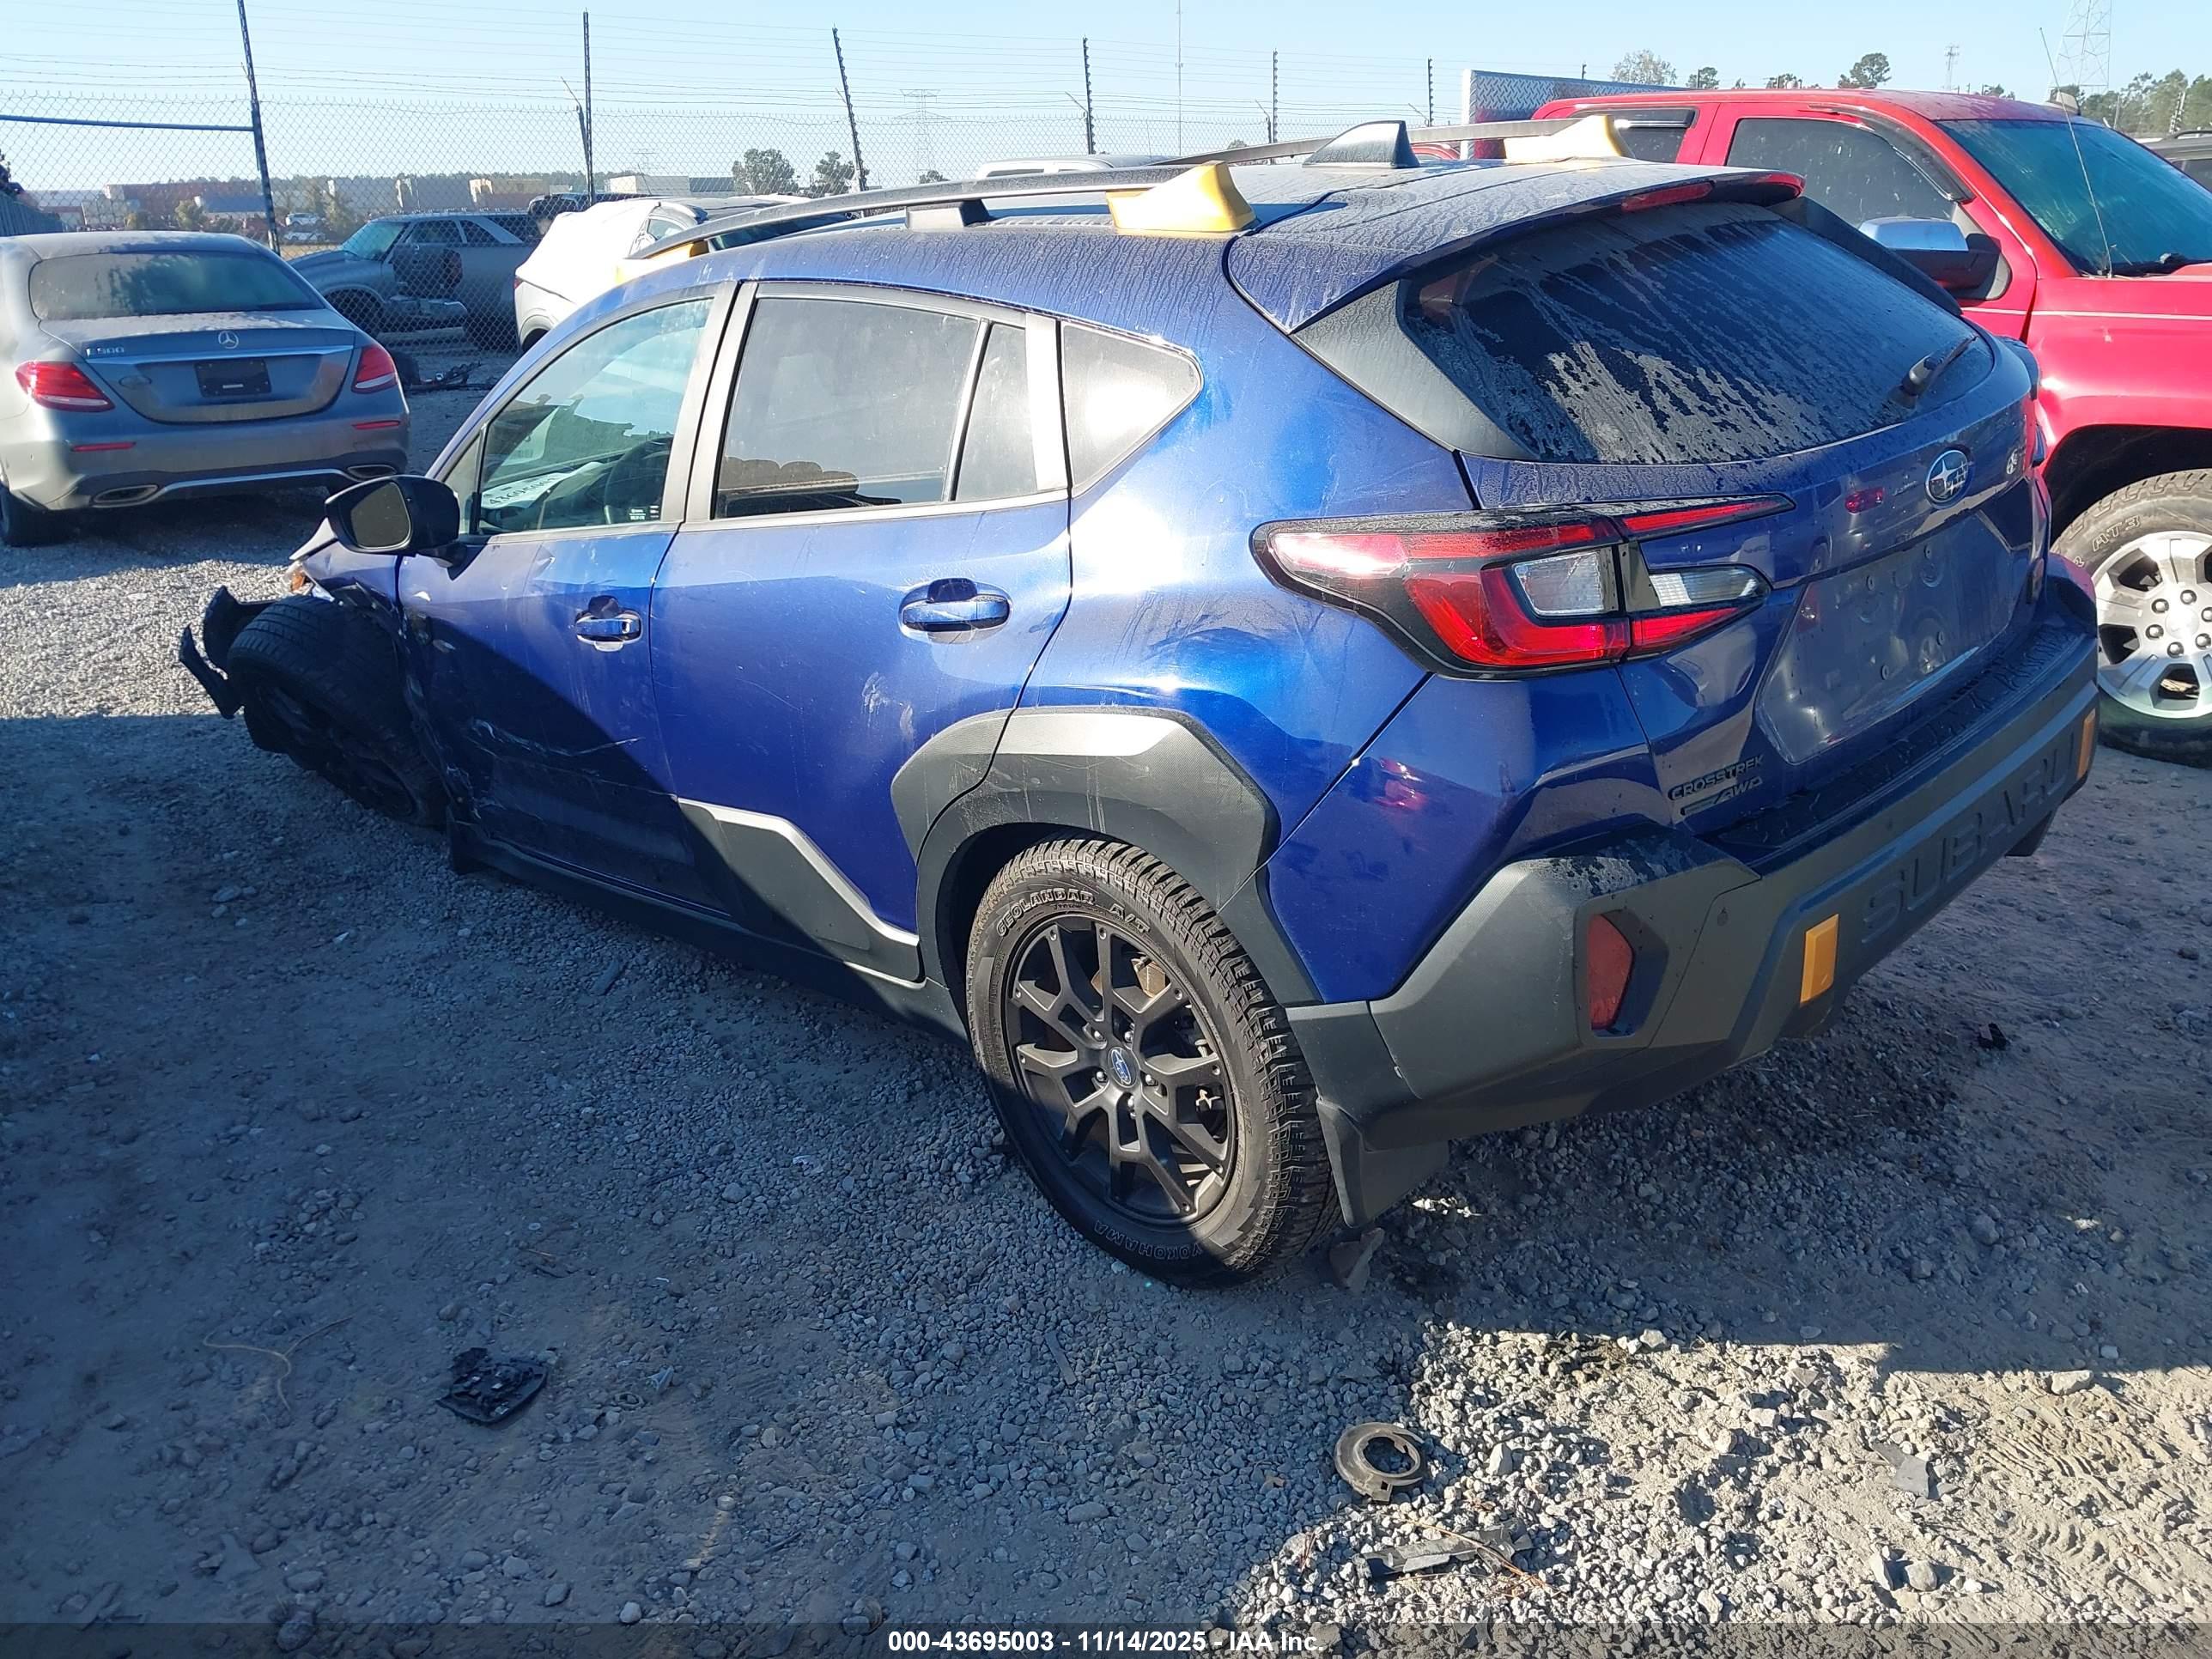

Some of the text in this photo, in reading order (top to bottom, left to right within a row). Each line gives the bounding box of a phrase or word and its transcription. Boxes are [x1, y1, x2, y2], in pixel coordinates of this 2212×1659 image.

[1668, 754, 1765, 801] CROSSTREK
[1717, 775, 1763, 804] AWD
[1860, 730, 2075, 945] SUBARU
[996, 887, 1152, 938] GEOLANDAR A/T
[1093, 1219, 1202, 1260] YOKOHAMA
